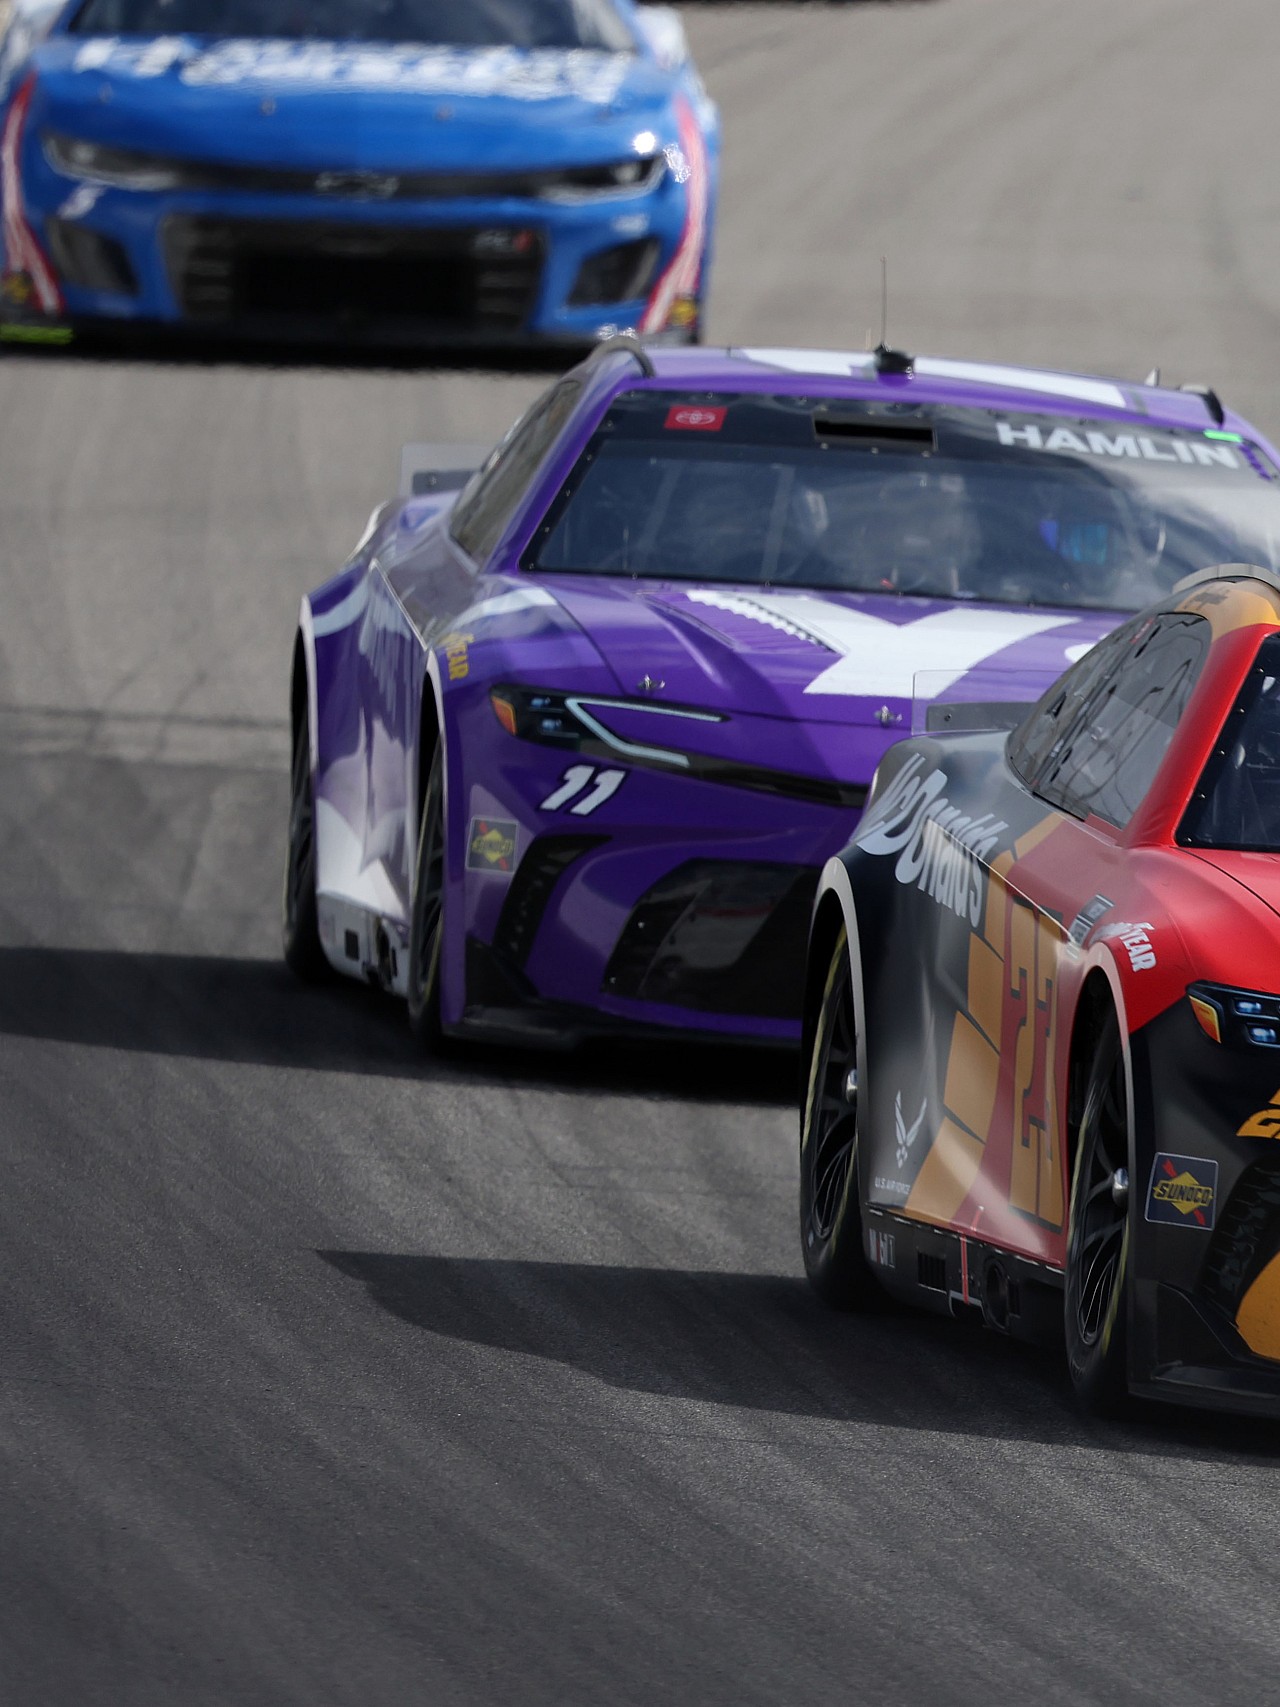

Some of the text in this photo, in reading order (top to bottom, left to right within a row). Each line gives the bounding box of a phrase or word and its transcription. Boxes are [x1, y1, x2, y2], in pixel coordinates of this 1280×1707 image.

[996, 422, 1240, 469] HAMLIN
[539, 764, 627, 816] 11
[1155, 1181, 1213, 1206] SUNOCO
